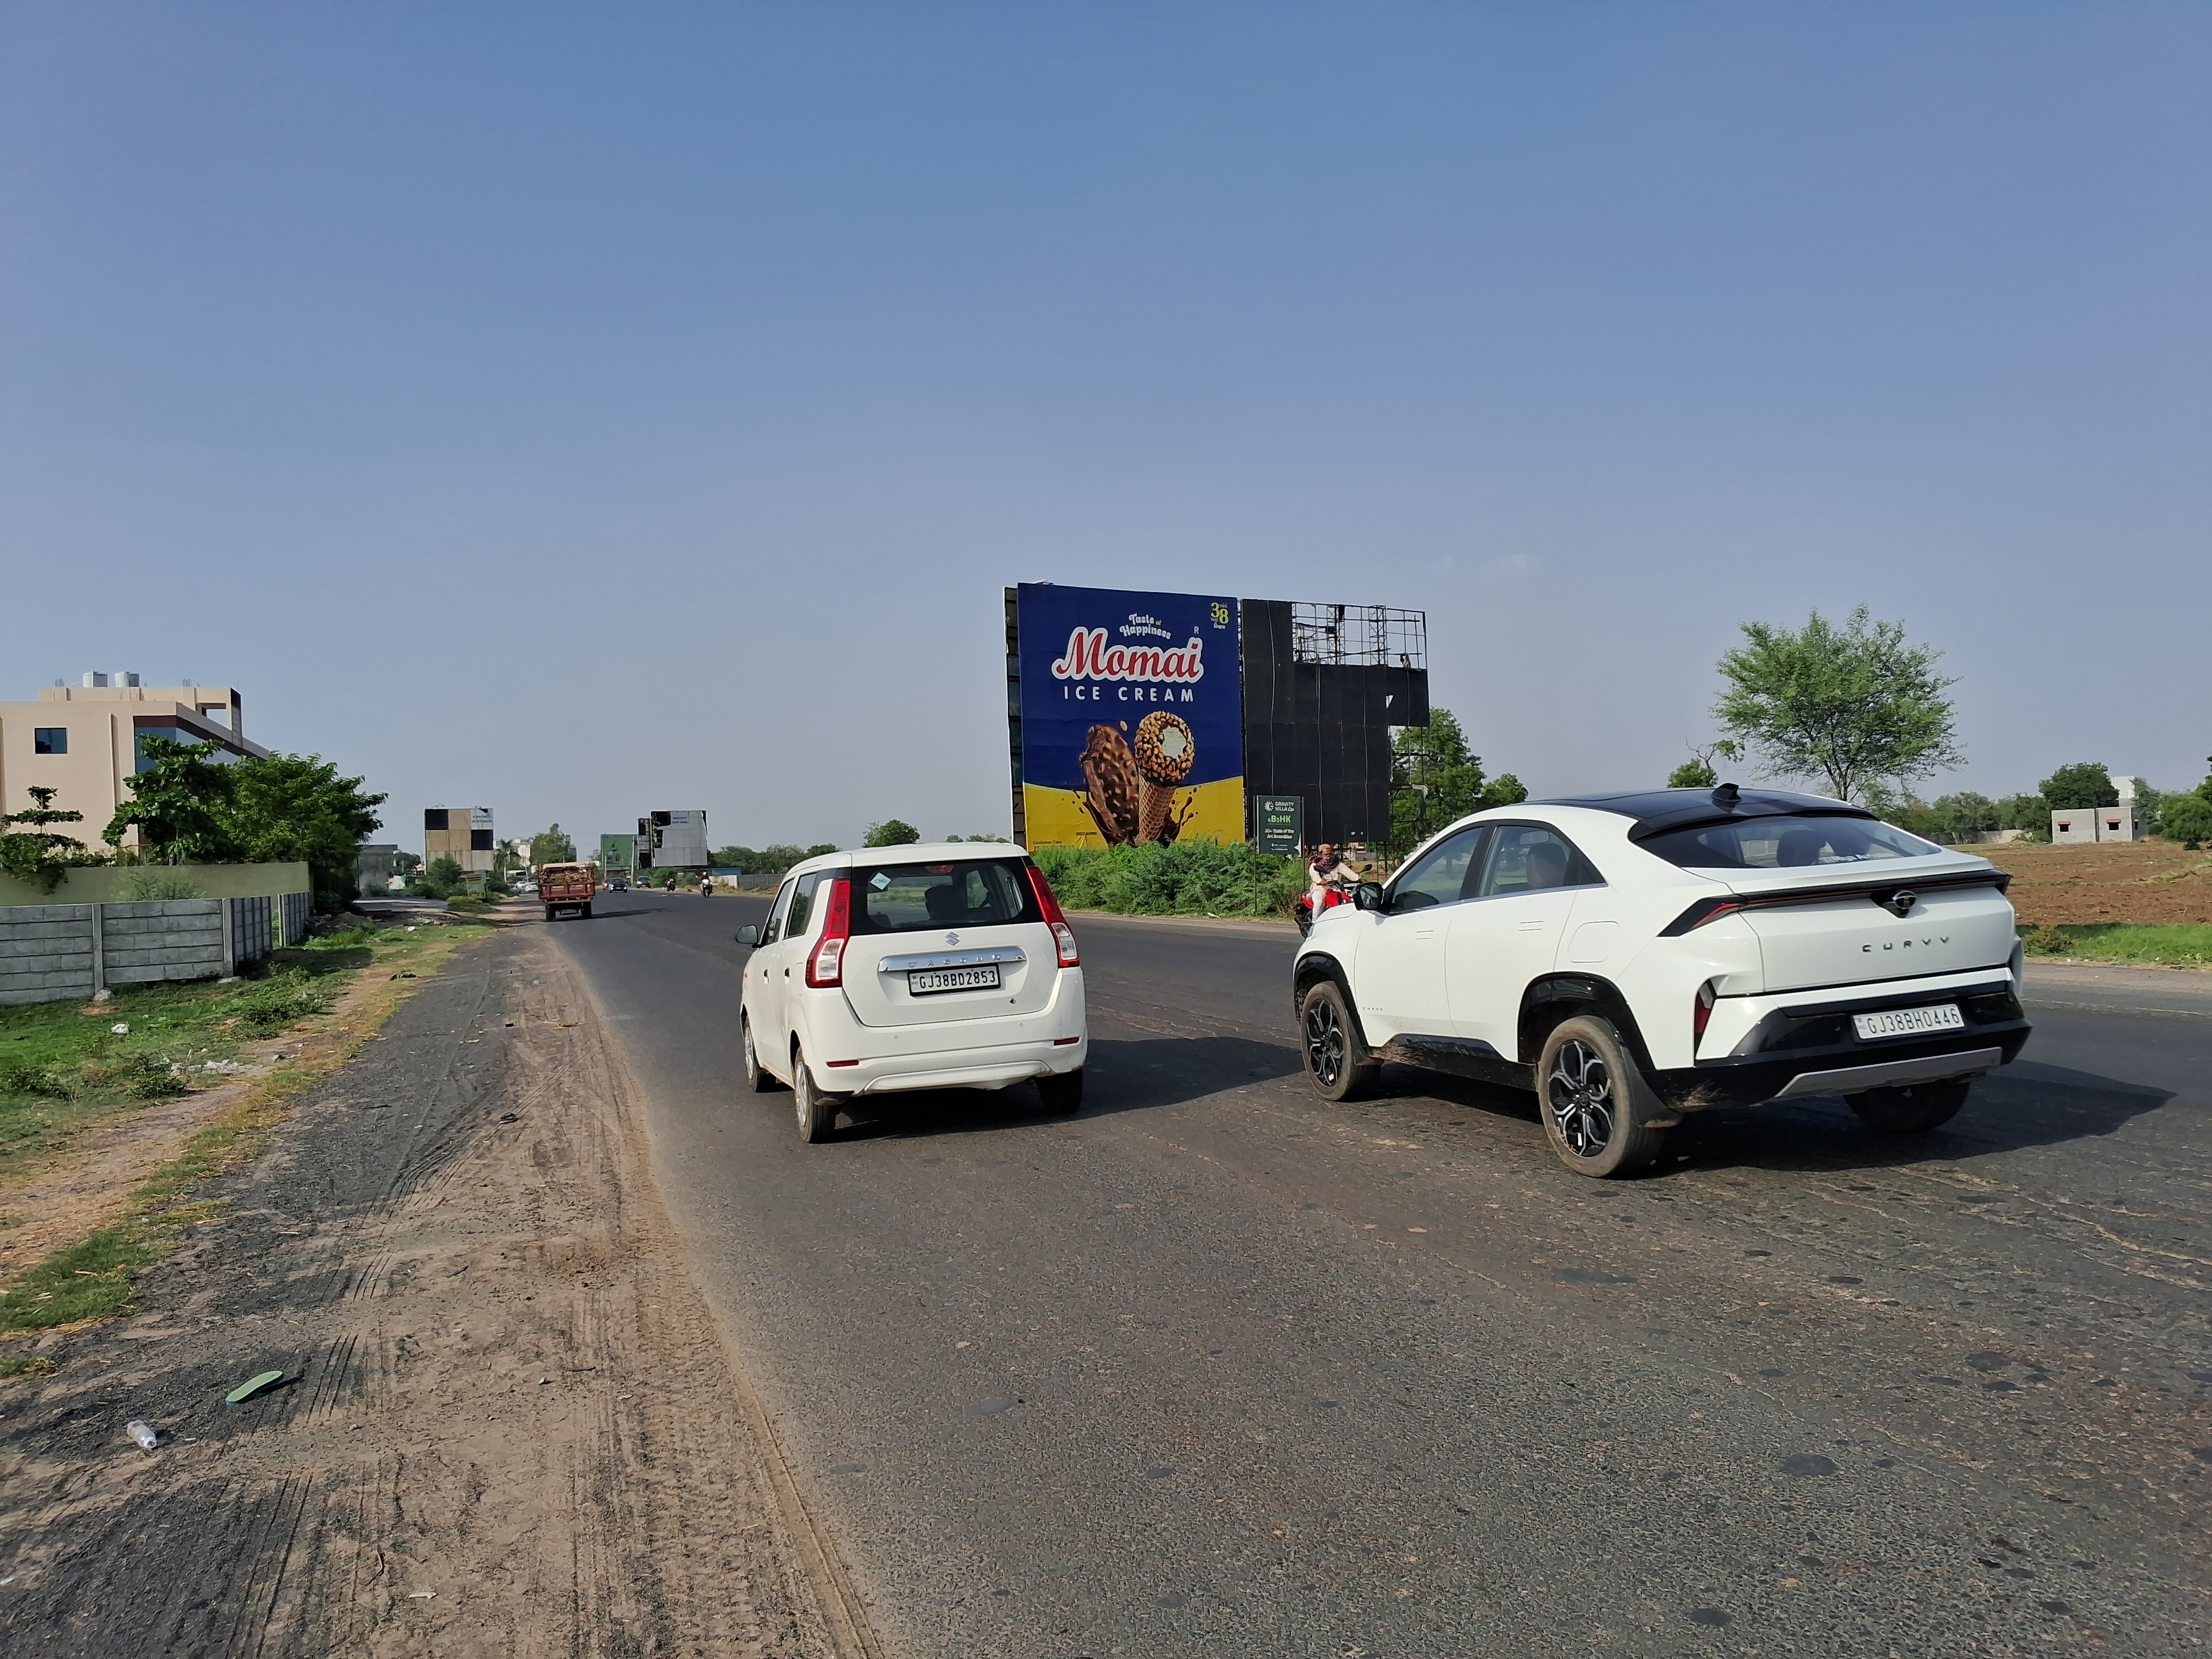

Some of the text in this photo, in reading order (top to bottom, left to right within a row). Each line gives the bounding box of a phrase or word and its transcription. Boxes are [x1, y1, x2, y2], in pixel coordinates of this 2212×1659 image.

[1128, 612, 1155, 625] Taste
[1211, 602, 1229, 624] 38
[1119, 624, 1172, 640] Happiness
[1054, 630, 1201, 680] Momai
[1064, 686, 1194, 702] ICE CREAM
[1862, 936, 1950, 953] CURVV
[919, 970, 996, 989] GJ38BD2853
[1867, 1008, 1960, 1034] GJ38BH0446
